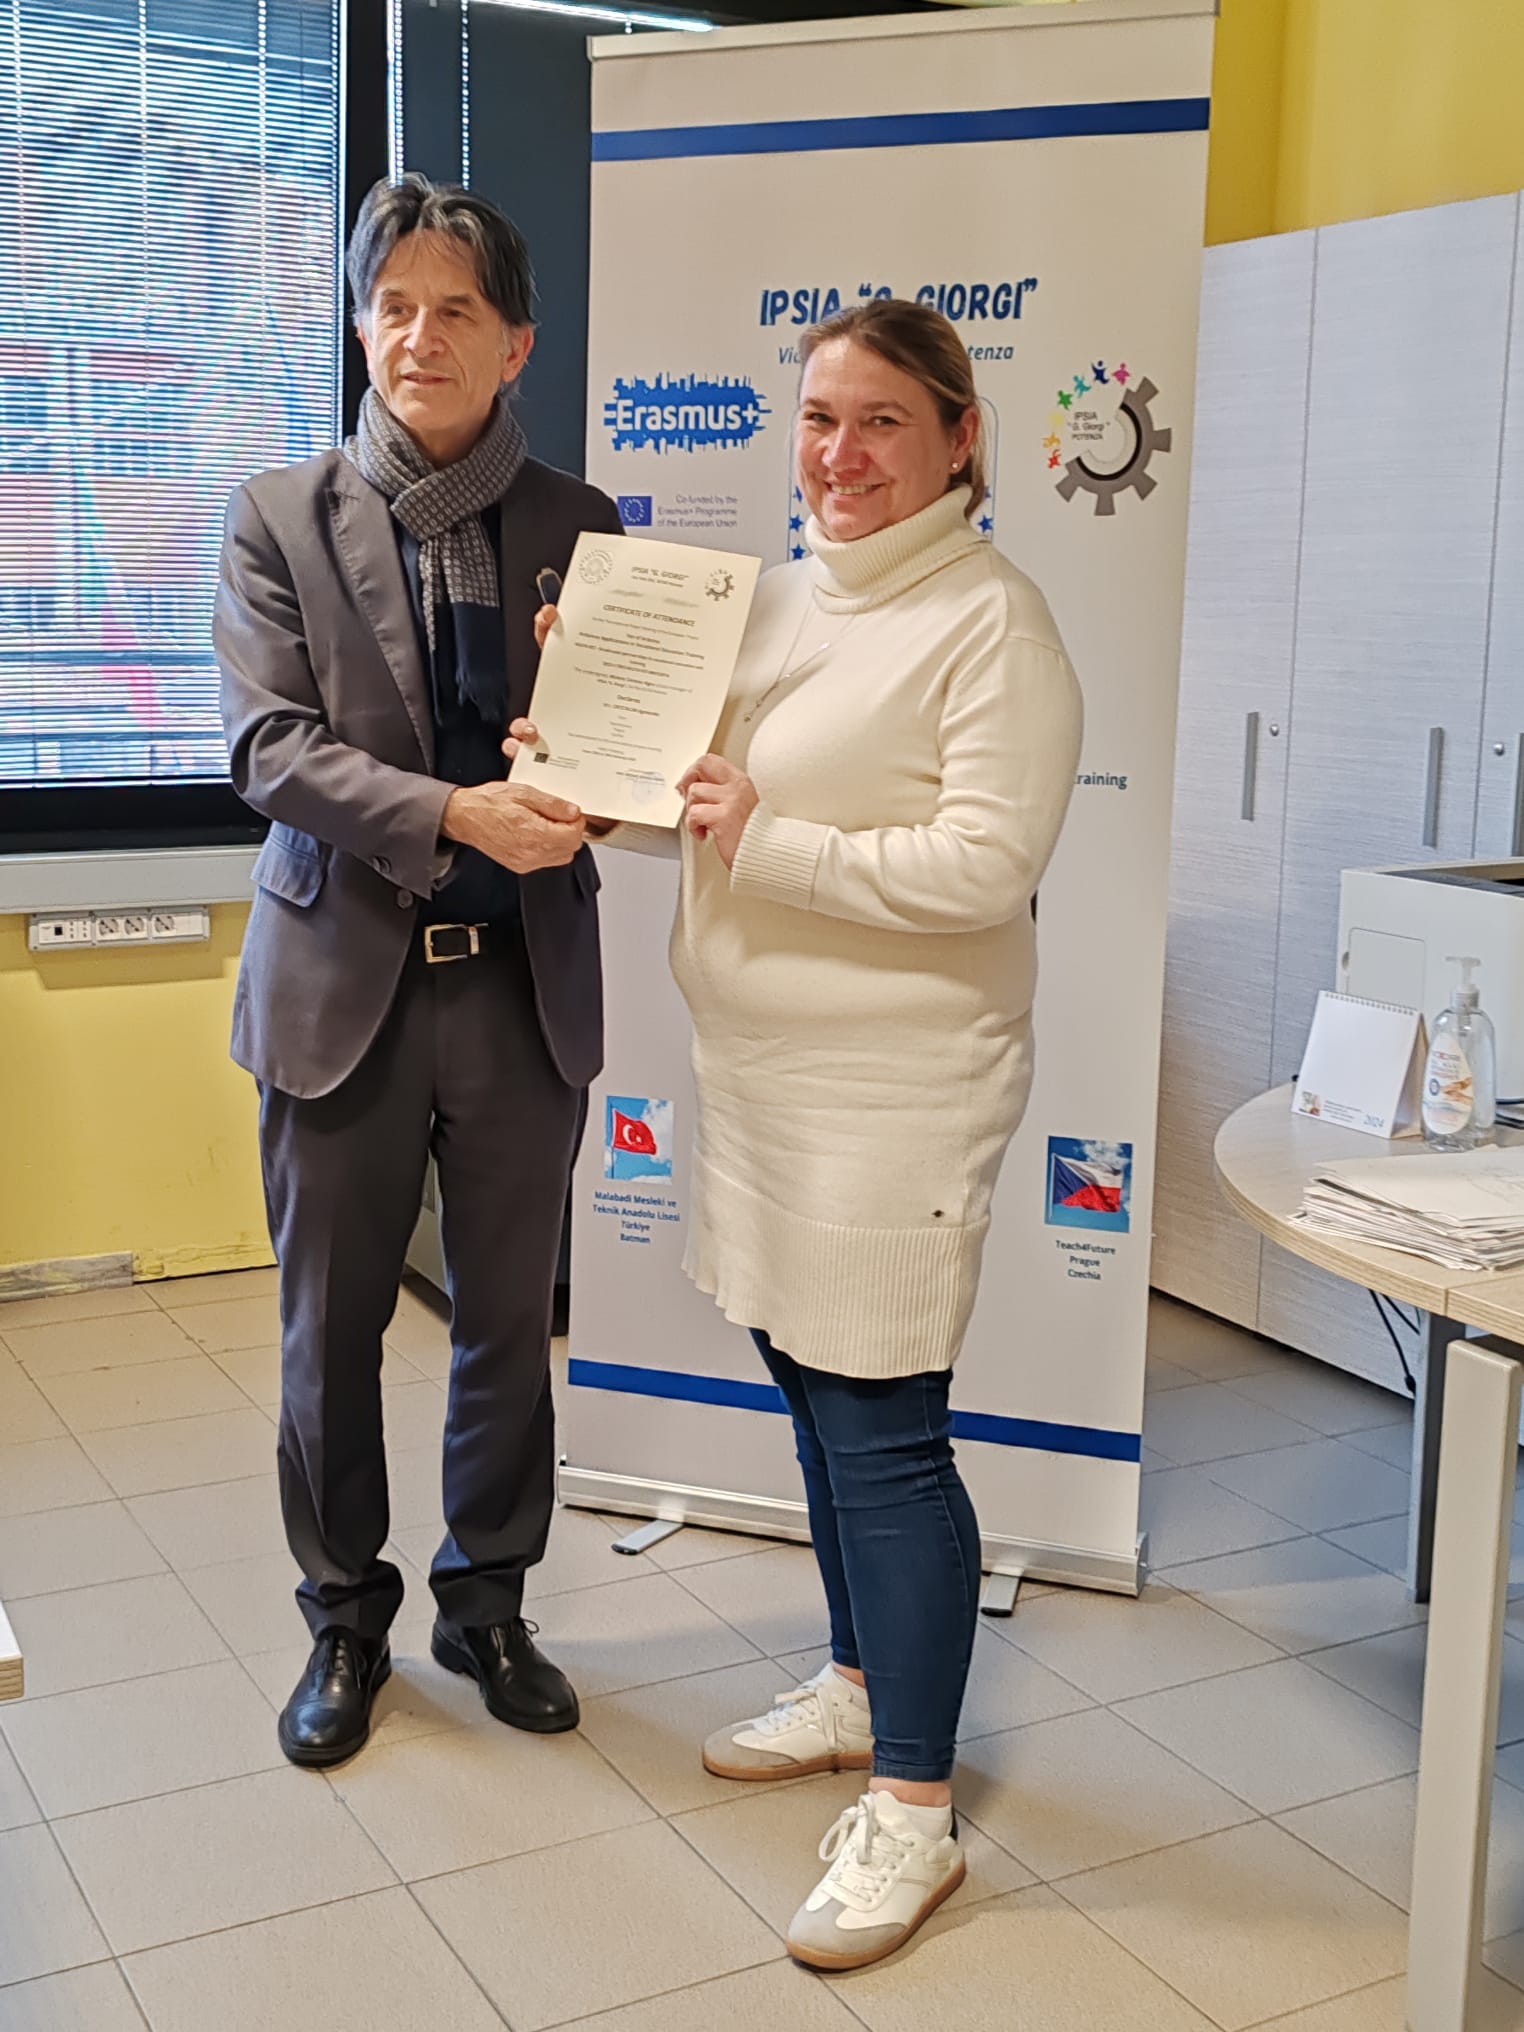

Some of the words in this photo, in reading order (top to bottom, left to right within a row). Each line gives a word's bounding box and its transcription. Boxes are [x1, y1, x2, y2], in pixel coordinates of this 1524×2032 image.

[760, 288, 841, 325] IPSIA
[967, 345, 1014, 361] tenza
[616, 399, 759, 431] Erasmus+
[1074, 412, 1098, 421] IPSIA
[725, 496, 738, 505] the
[695, 507, 738, 517] Programme
[666, 519, 678, 527] the
[679, 520, 714, 529] European
[716, 519, 738, 528] Union
[1076, 771, 1129, 791] raining
[594, 1191, 631, 1203] Malabadi
[633, 1194, 666, 1206] Mesleki
[667, 1199, 678, 1208] ve
[592, 1204, 619, 1215] Teknik
[621, 1208, 655, 1219] Anadolu
[657, 1211, 681, 1222] Lisesi
[621, 1220, 650, 1232] Türkiye
[620, 1233, 651, 1244] Batman
[1069, 1255, 1101, 1267] Prague
[1067, 1269, 1102, 1281] Czechia
